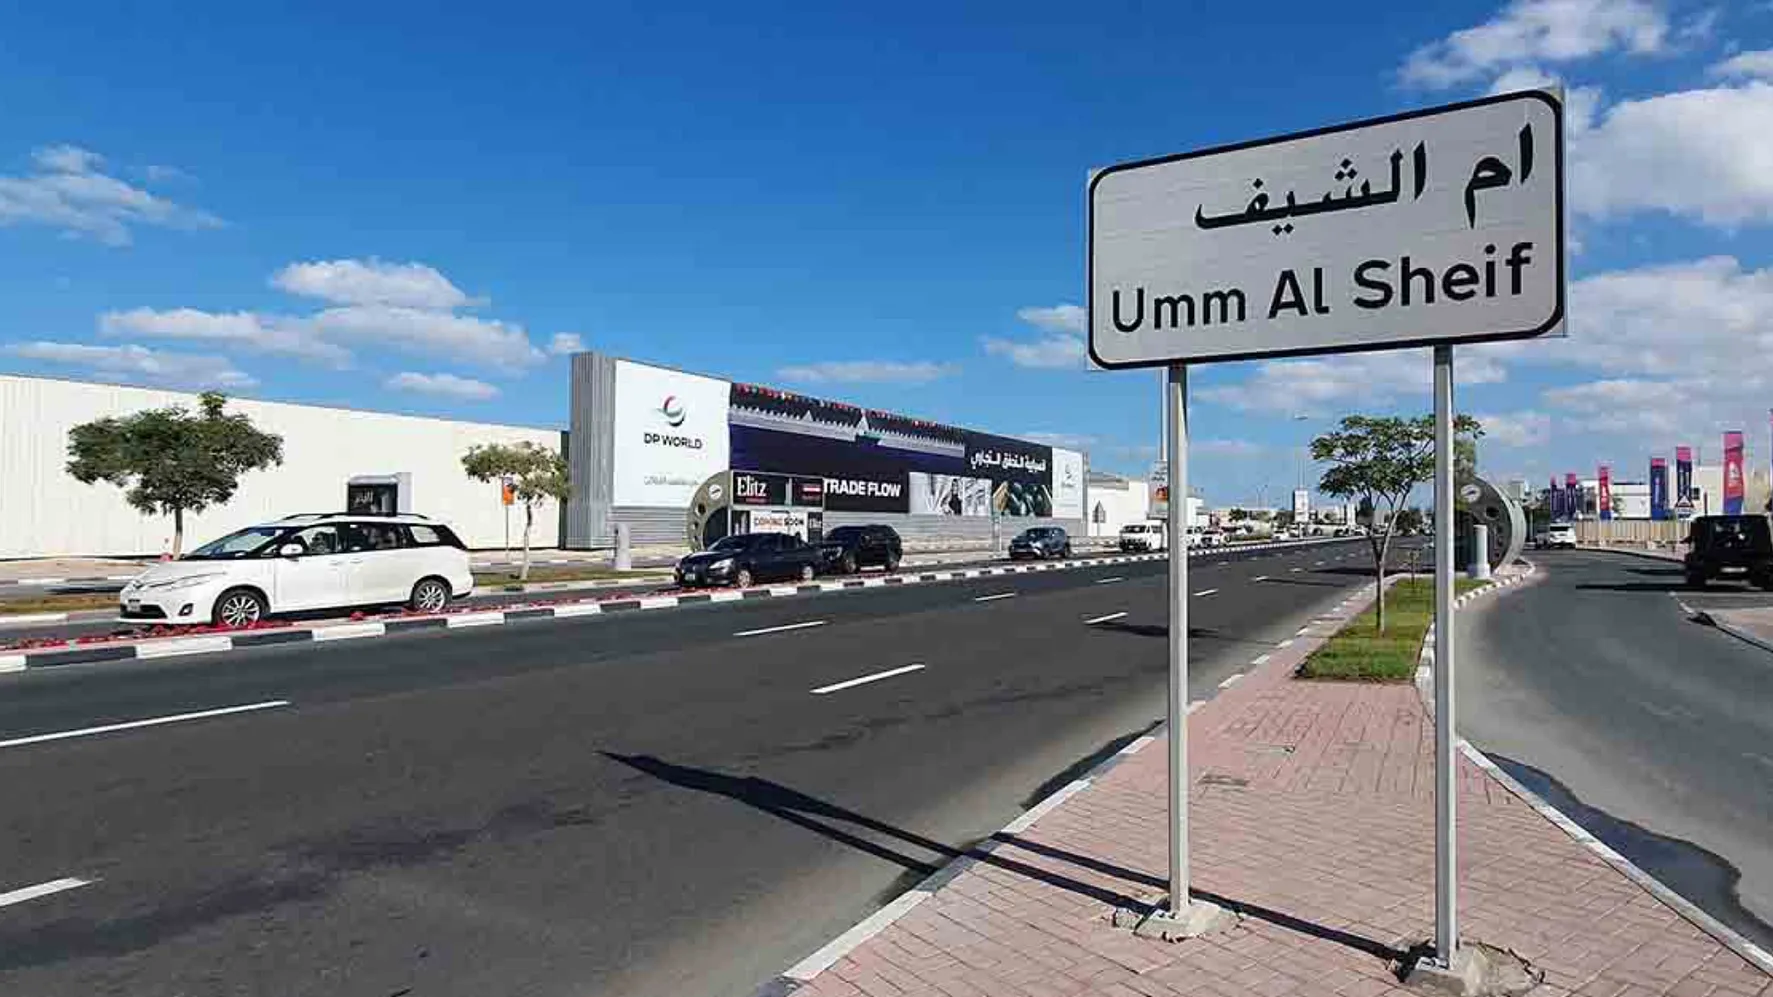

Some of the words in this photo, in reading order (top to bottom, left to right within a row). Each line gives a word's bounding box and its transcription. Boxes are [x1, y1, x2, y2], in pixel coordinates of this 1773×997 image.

[1194, 140, 1427, 236] الشيف
[1463, 122, 1534, 229] ام
[1112, 286, 1246, 333] Umm
[1267, 267, 1330, 320] Al
[1353, 241, 1534, 310] Sheif
[643, 432, 661, 444] DP
[661, 434, 703, 450] WORLD
[736, 475, 767, 497] Elitz
[823, 478, 866, 496] TRADE
[866, 481, 902, 498] FLOW
